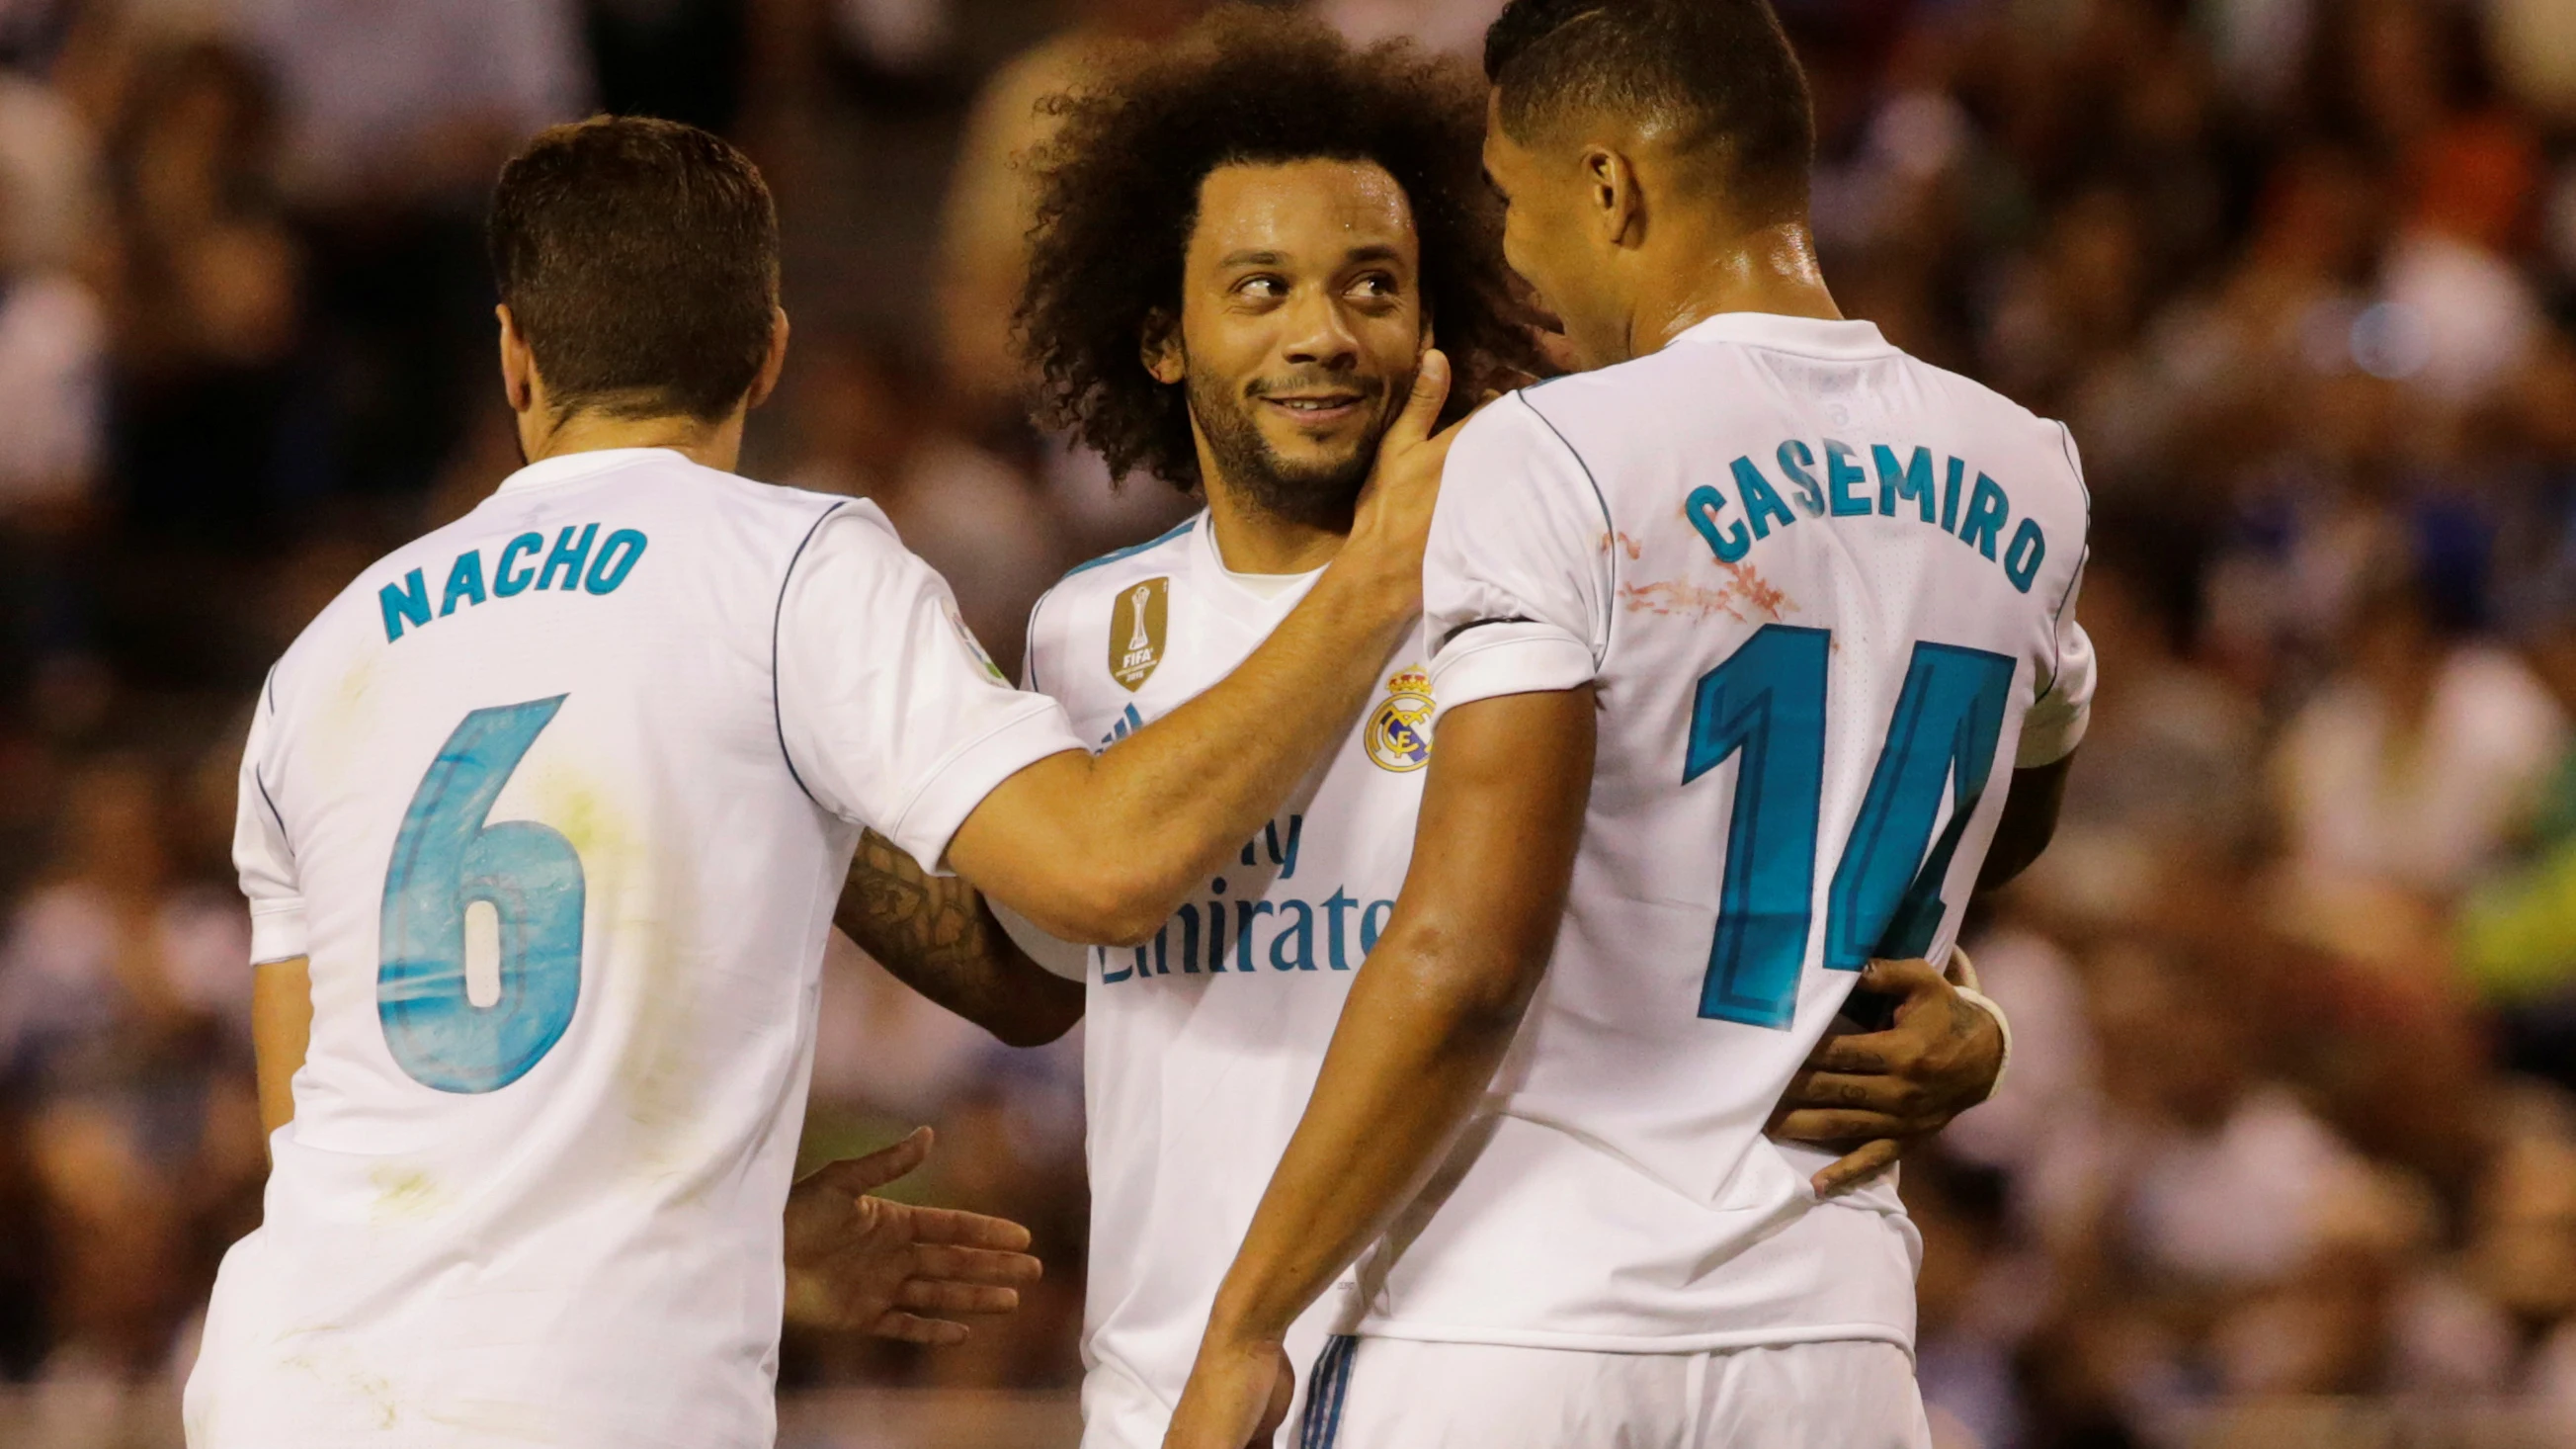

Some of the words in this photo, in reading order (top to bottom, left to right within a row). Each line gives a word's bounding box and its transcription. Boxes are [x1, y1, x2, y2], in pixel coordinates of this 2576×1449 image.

[378, 523, 648, 643] NACHO
[1685, 437, 2045, 593] CASEMIRO
[1122, 647, 1152, 669] FIFA
[376, 692, 586, 1095] 6
[1682, 624, 2017, 1032] 14
[1097, 876, 1395, 984] mirat
